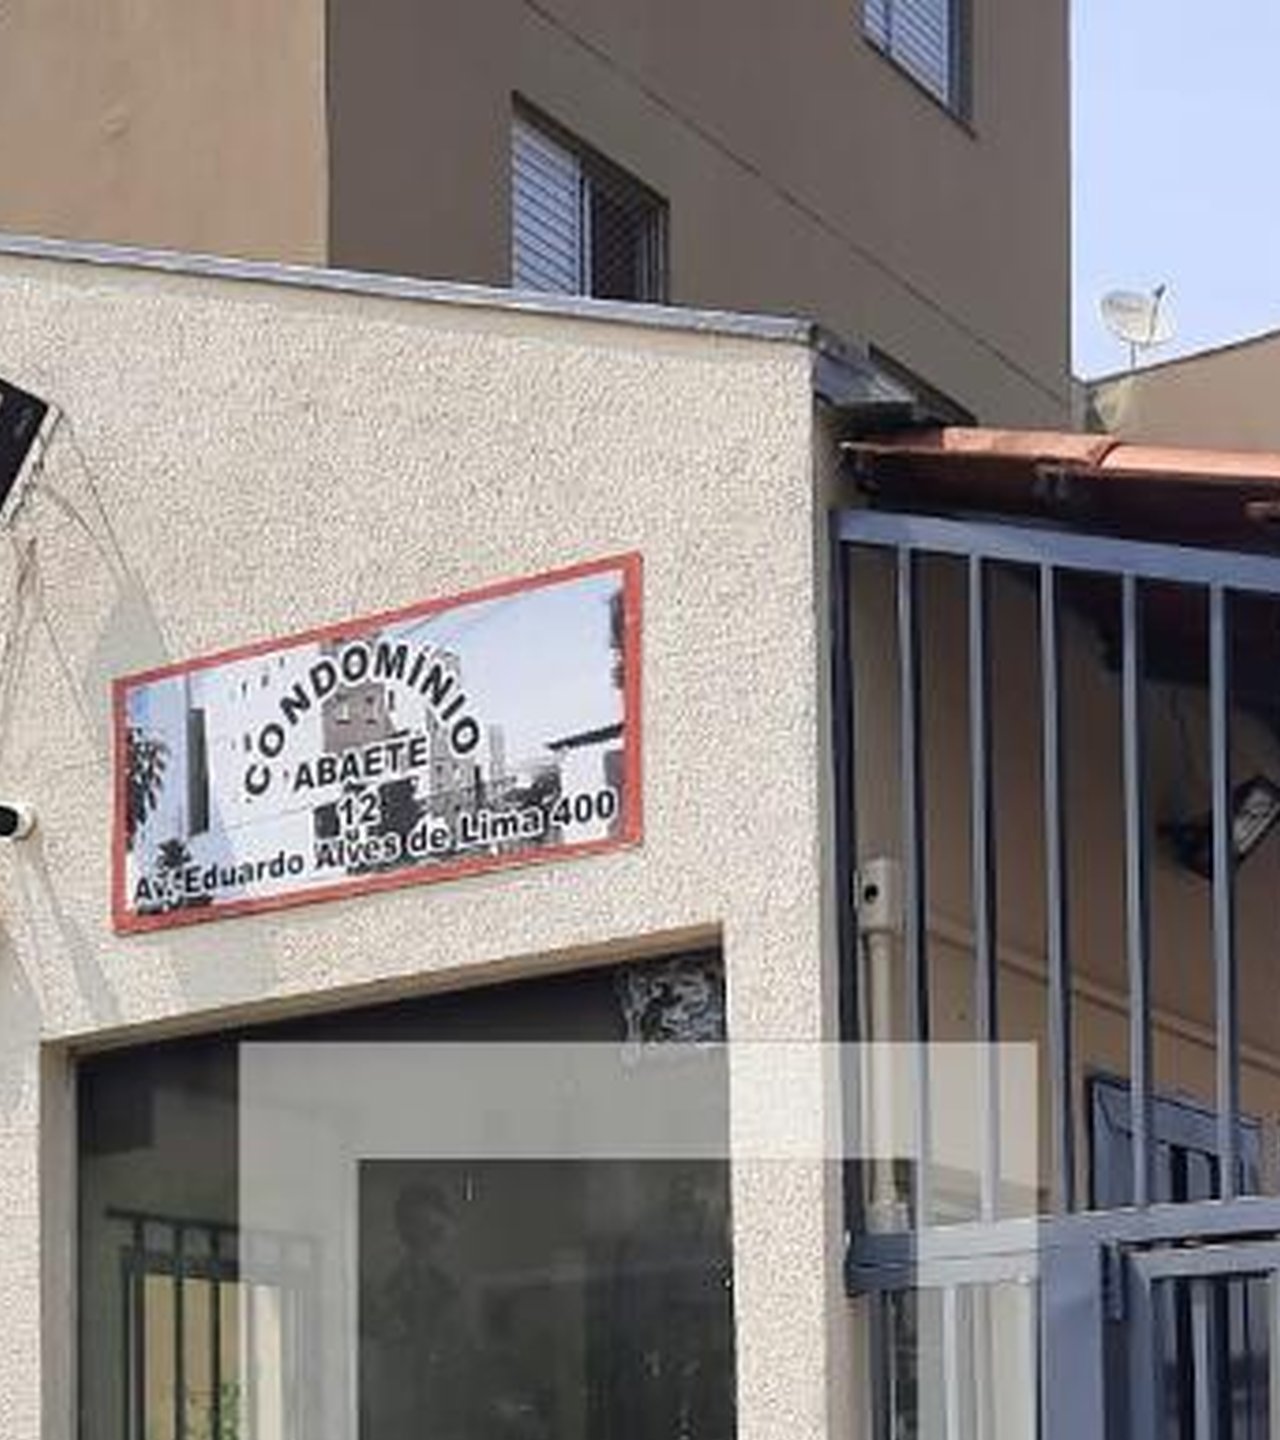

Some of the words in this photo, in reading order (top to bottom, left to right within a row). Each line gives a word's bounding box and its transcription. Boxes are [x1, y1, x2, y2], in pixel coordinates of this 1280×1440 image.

[339, 793, 379, 826] 12
[133, 877, 173, 902] Av.
[185, 851, 304, 894] Eduardo
[315, 834, 400, 869] Alves
[410, 821, 448, 851] de
[463, 811, 540, 842] Lima
[553, 790, 615, 825] 400
